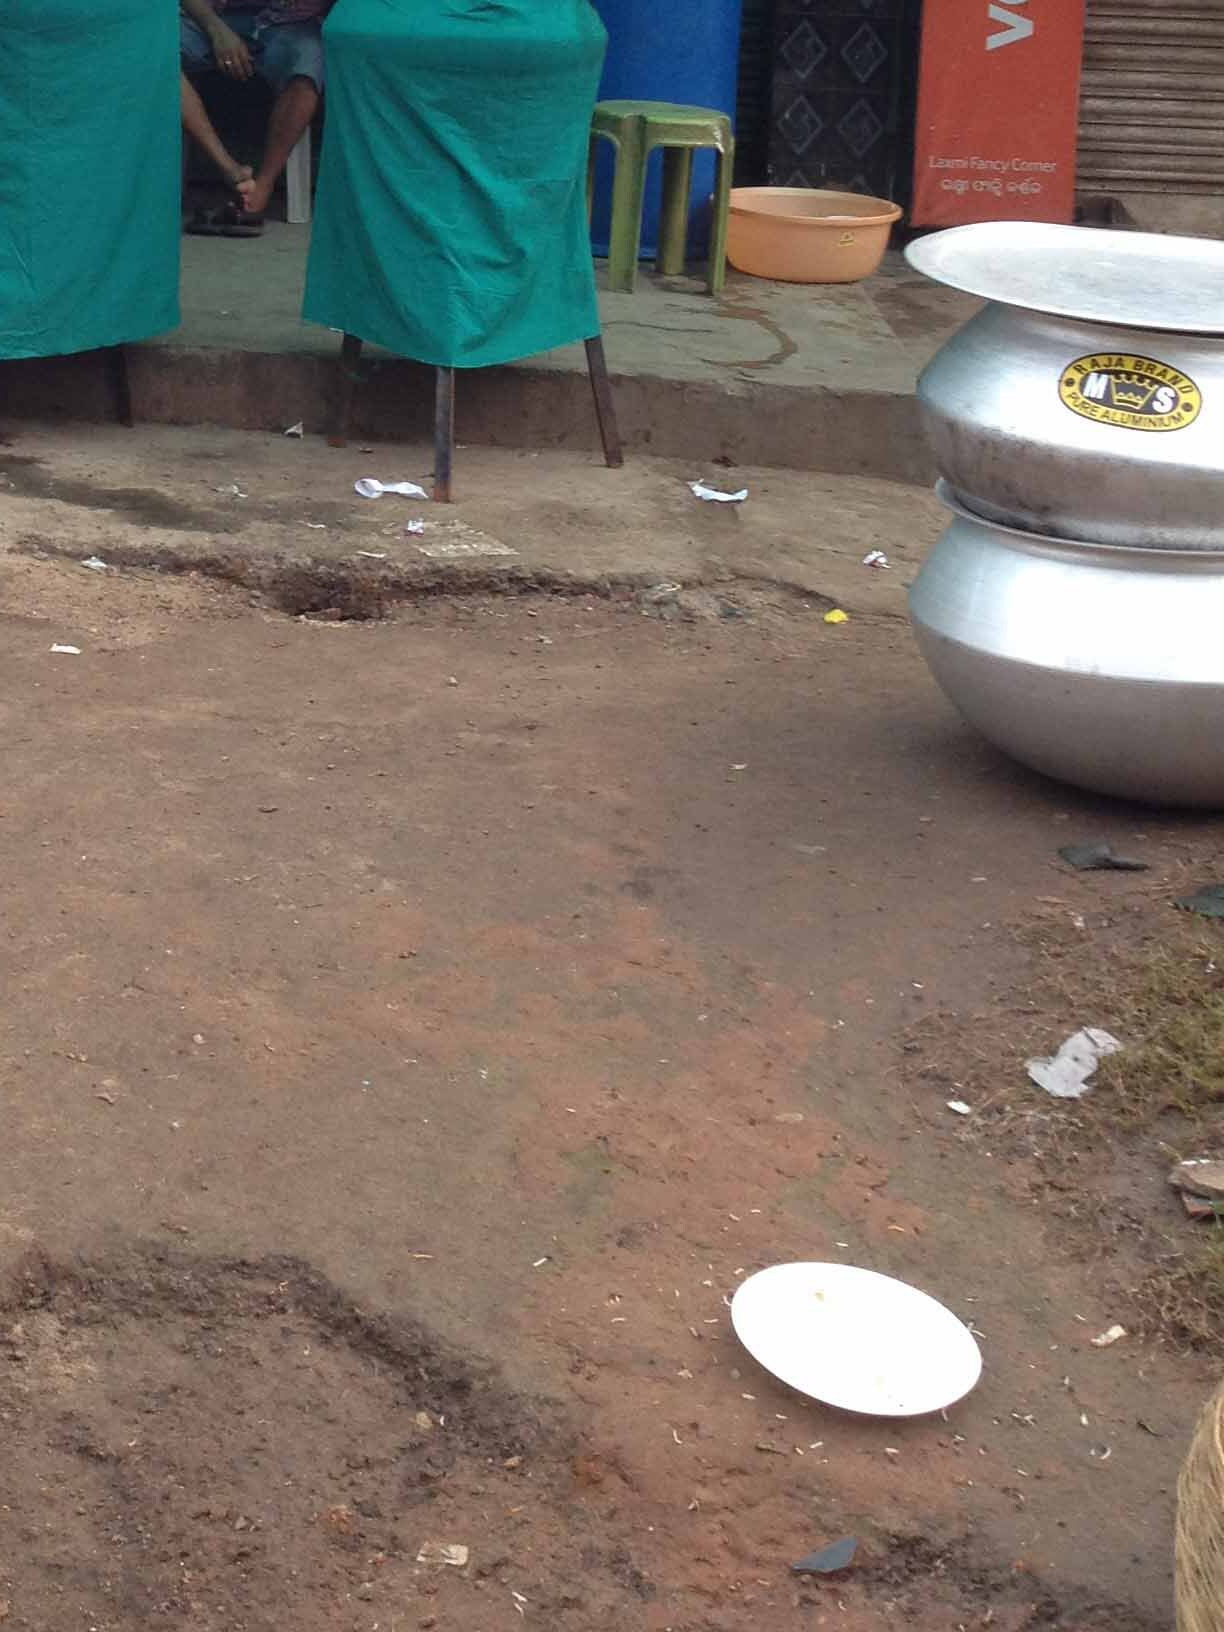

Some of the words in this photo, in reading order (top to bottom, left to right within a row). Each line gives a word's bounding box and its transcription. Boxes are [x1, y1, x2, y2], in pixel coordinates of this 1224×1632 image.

[1073, 357, 1126, 376] RAJA
[1133, 359, 1195, 395] BRAND
[1083, 372, 1110, 400] M
[1151, 386, 1177, 414] S
[1065, 391, 1101, 418] PURE
[1100, 411, 1186, 429] ALUMINIUM
